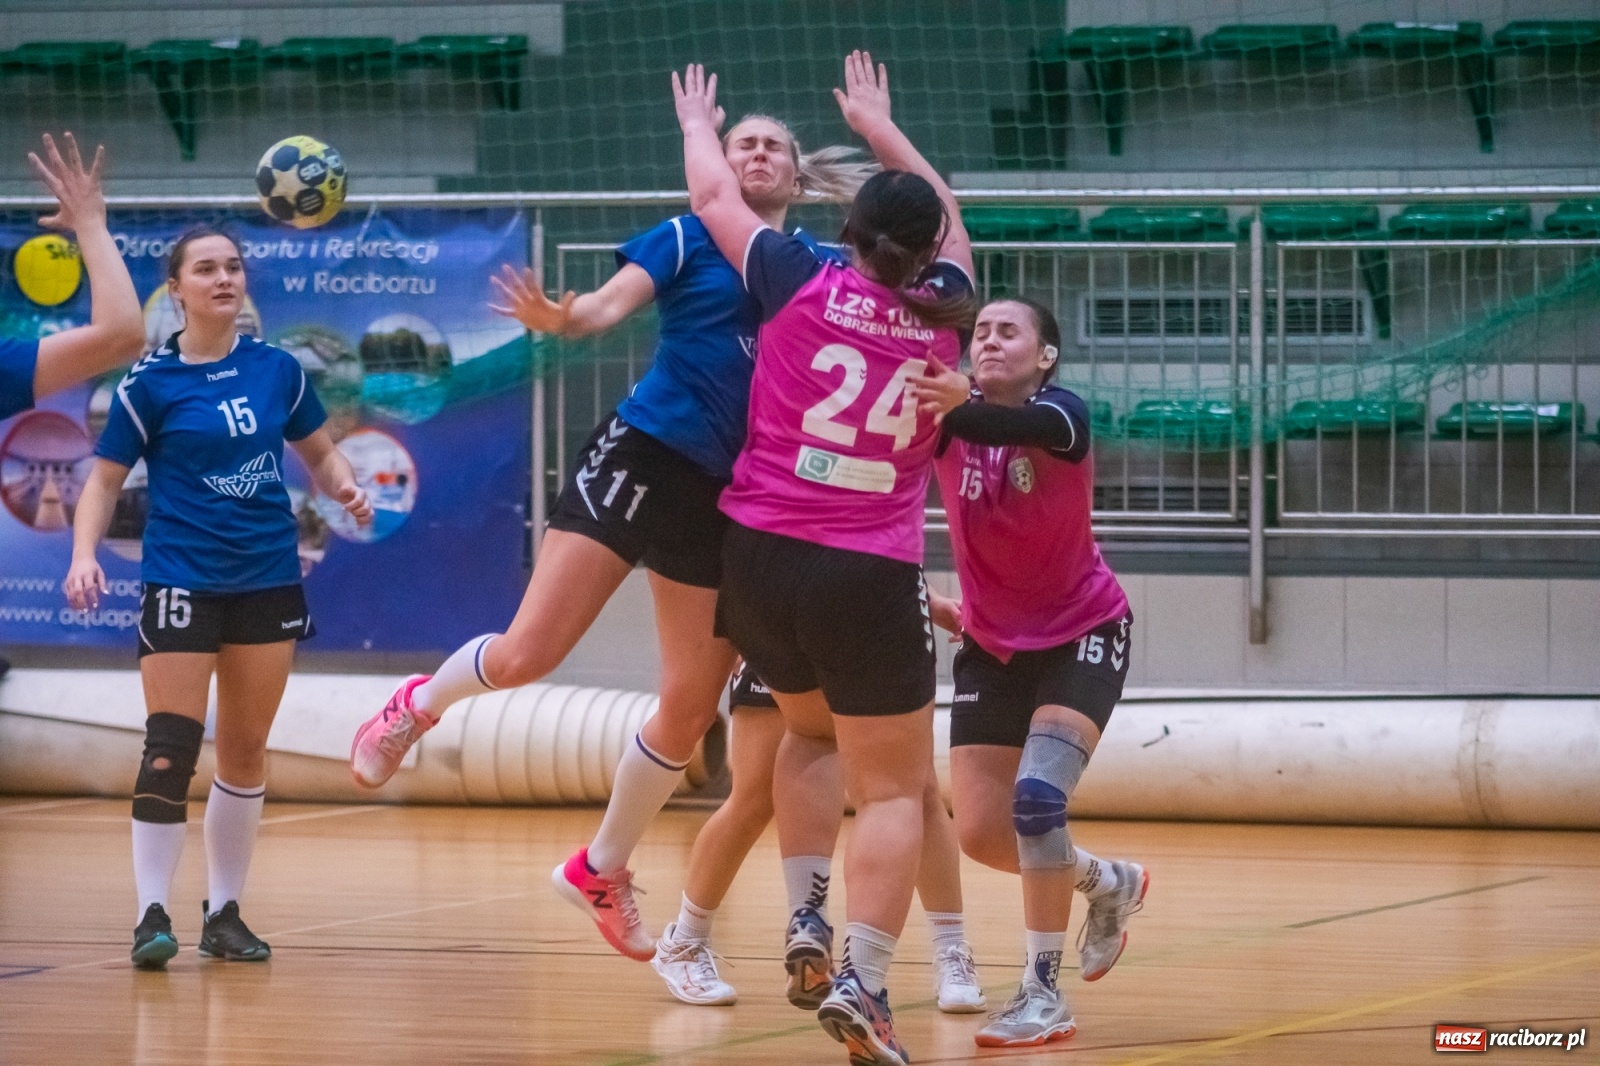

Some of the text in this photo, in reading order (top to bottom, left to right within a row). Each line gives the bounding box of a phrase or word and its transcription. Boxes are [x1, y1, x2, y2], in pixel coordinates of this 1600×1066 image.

[112, 232, 441, 264] Ośro ortu i Rekreacji
[282, 270, 437, 295] w Raciborzu
[826, 286, 922, 328] LZS TU
[890, 325, 935, 341] WIELKI
[206, 367, 239, 383] hummel
[801, 343, 928, 454] 24
[216, 396, 258, 438] 15
[602, 469, 649, 522] 11
[958, 467, 983, 501] 15
[155, 586, 192, 629] 15
[1074, 634, 1105, 665] 15
[750, 682, 770, 694] hum
[953, 691, 979, 703] ummel
